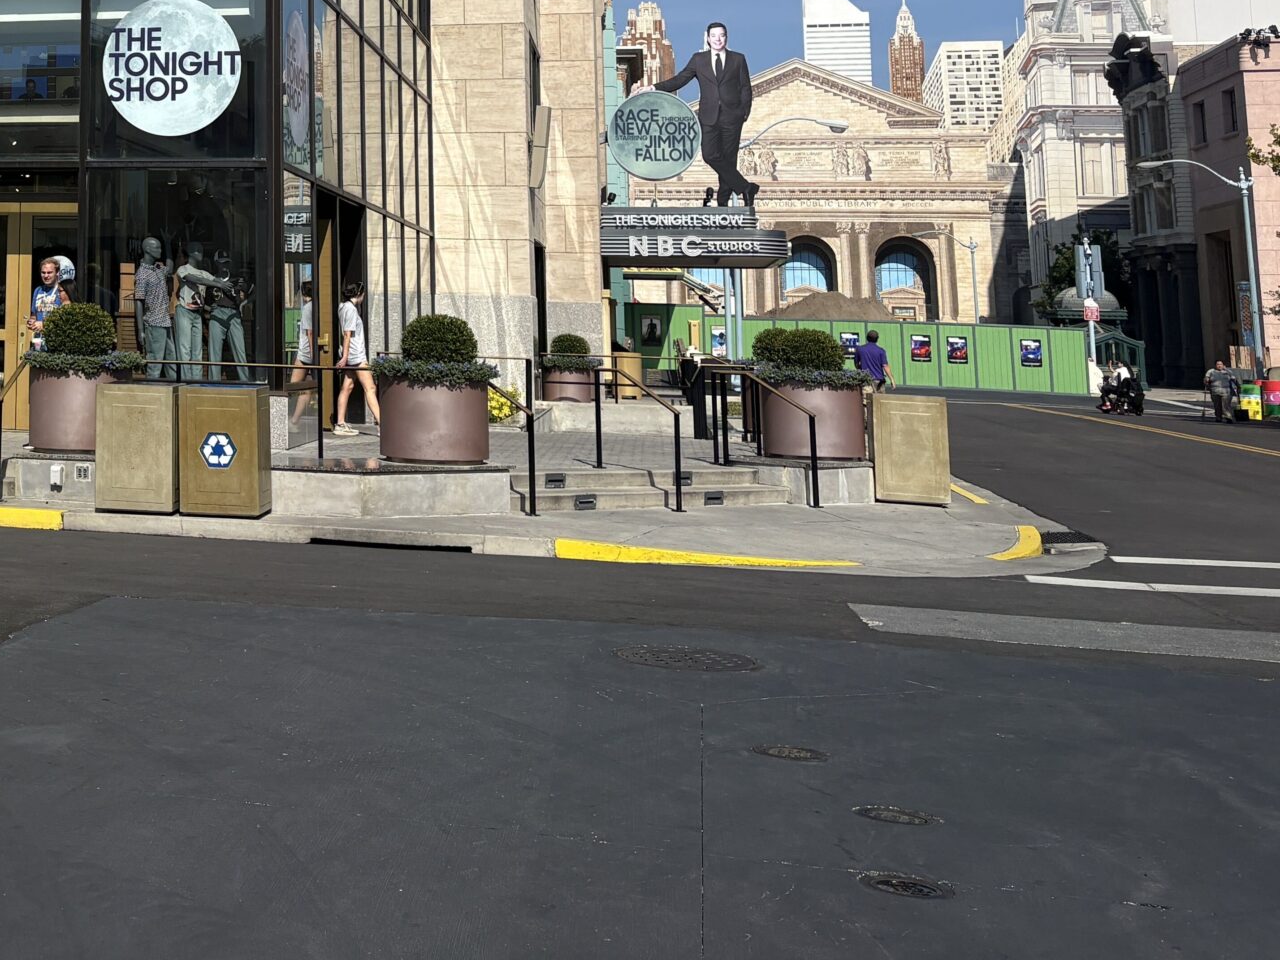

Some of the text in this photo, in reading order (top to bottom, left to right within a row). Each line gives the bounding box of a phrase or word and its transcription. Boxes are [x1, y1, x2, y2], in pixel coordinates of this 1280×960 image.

[111, 26, 162, 52] THE
[109, 50, 242, 77] TONIGHT
[109, 76, 189, 102] SHOP
[615, 108, 660, 122] RACE
[615, 122, 698, 136] NEW YORK
[644, 135, 697, 149] JIMMY
[635, 148, 694, 162] FALLON
[614, 214, 744, 227] THE TONIGHT SHOW
[628, 235, 761, 257] NBC STUDIOS
